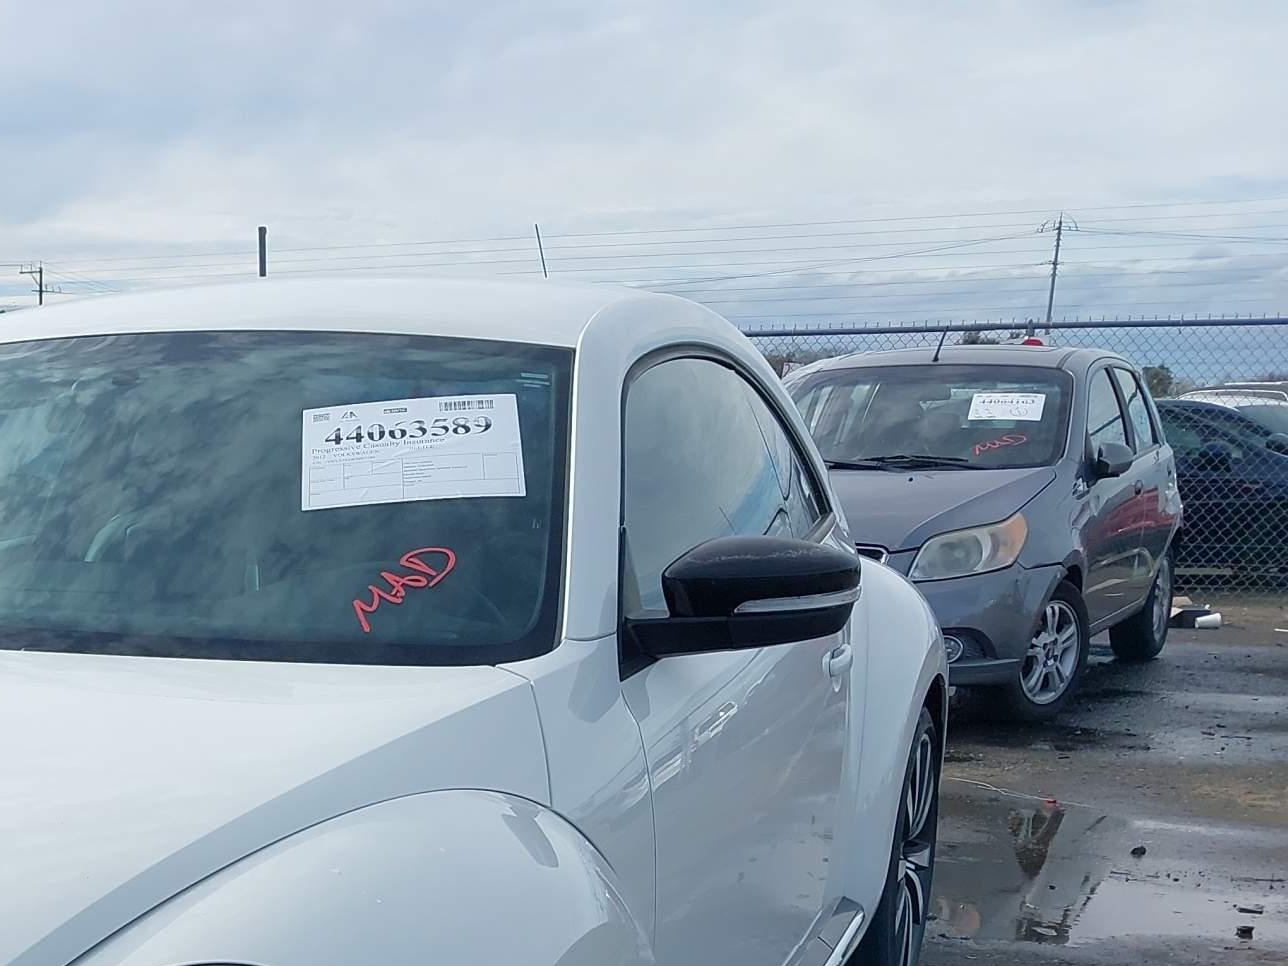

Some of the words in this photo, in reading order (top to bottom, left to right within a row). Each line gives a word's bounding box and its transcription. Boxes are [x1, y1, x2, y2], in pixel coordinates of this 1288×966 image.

[324, 416, 492, 445] 44063589
[311, 444, 361, 455] Progressive
[363, 439, 401, 449] Casualty
[403, 437, 446, 446] Insurance
